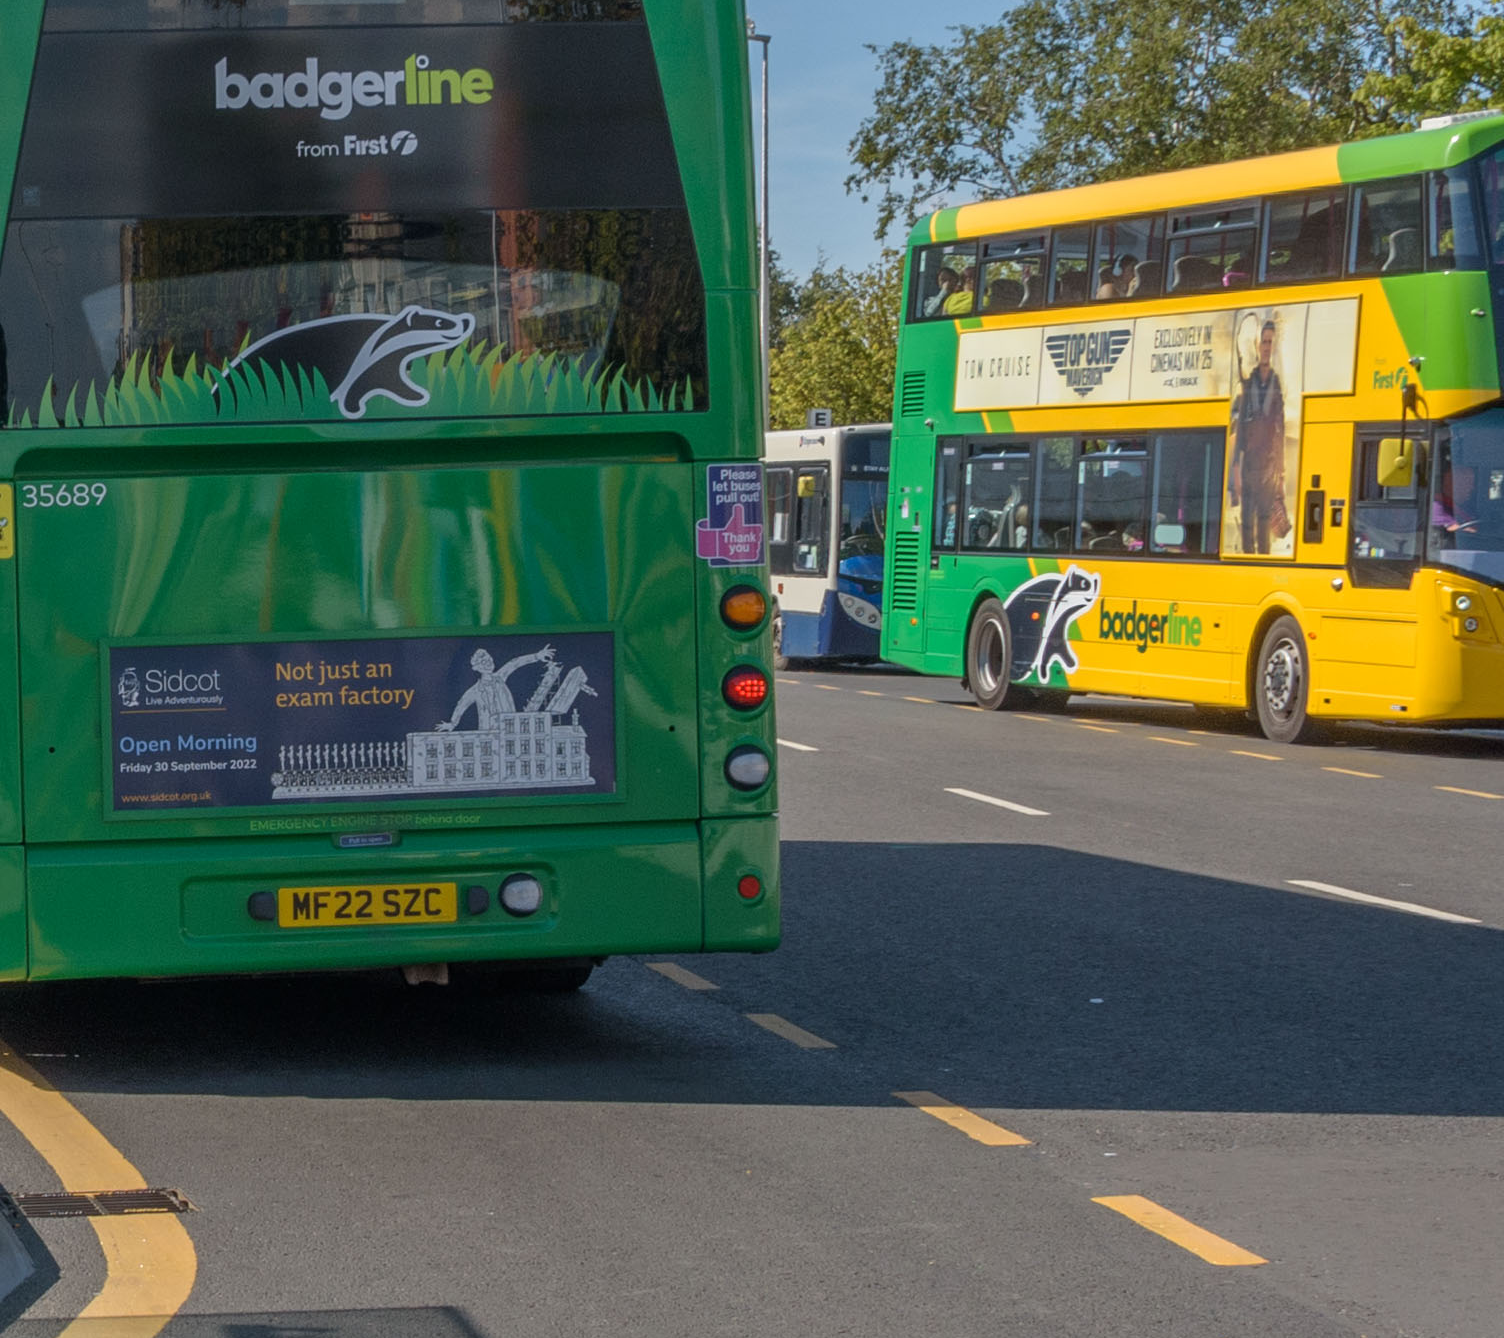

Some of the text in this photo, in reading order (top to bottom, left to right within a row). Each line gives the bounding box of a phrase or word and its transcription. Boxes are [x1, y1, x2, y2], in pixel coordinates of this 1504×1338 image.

[215, 53, 494, 121] badgerline
[296, 135, 388, 157] from First
[1063, 330, 1112, 367] TOP GUN
[964, 355, 1032, 379] TOM CRUISE
[1184, 351, 1201, 370] MAY
[1066, 367, 1103, 387] MAVERICK
[815, 412, 826, 426] E
[720, 469, 757, 480] Please
[22, 483, 107, 508] 35689
[712, 480, 761, 492] let buses
[716, 492, 738, 505] pull
[722, 532, 756, 543] Thank
[728, 543, 750, 555] you
[1099, 597, 1203, 653] badgerline
[145, 669, 221, 693] Sidcot
[275, 660, 393, 686] Not just an
[145, 694, 224, 706] Live Adventurously
[275, 686, 415, 709] exam factory
[119, 733, 258, 756] Open Morning
[119, 758, 258, 774] Friday 30 September 2022
[121, 791, 213, 804] www.sidcot.org.uk
[249, 818, 329, 832] EMERGENCY
[330, 815, 377, 829] ENGINE
[379, 814, 415, 827] STOP
[455, 813, 481, 824] door
[292, 888, 442, 920] MF22 SZC
